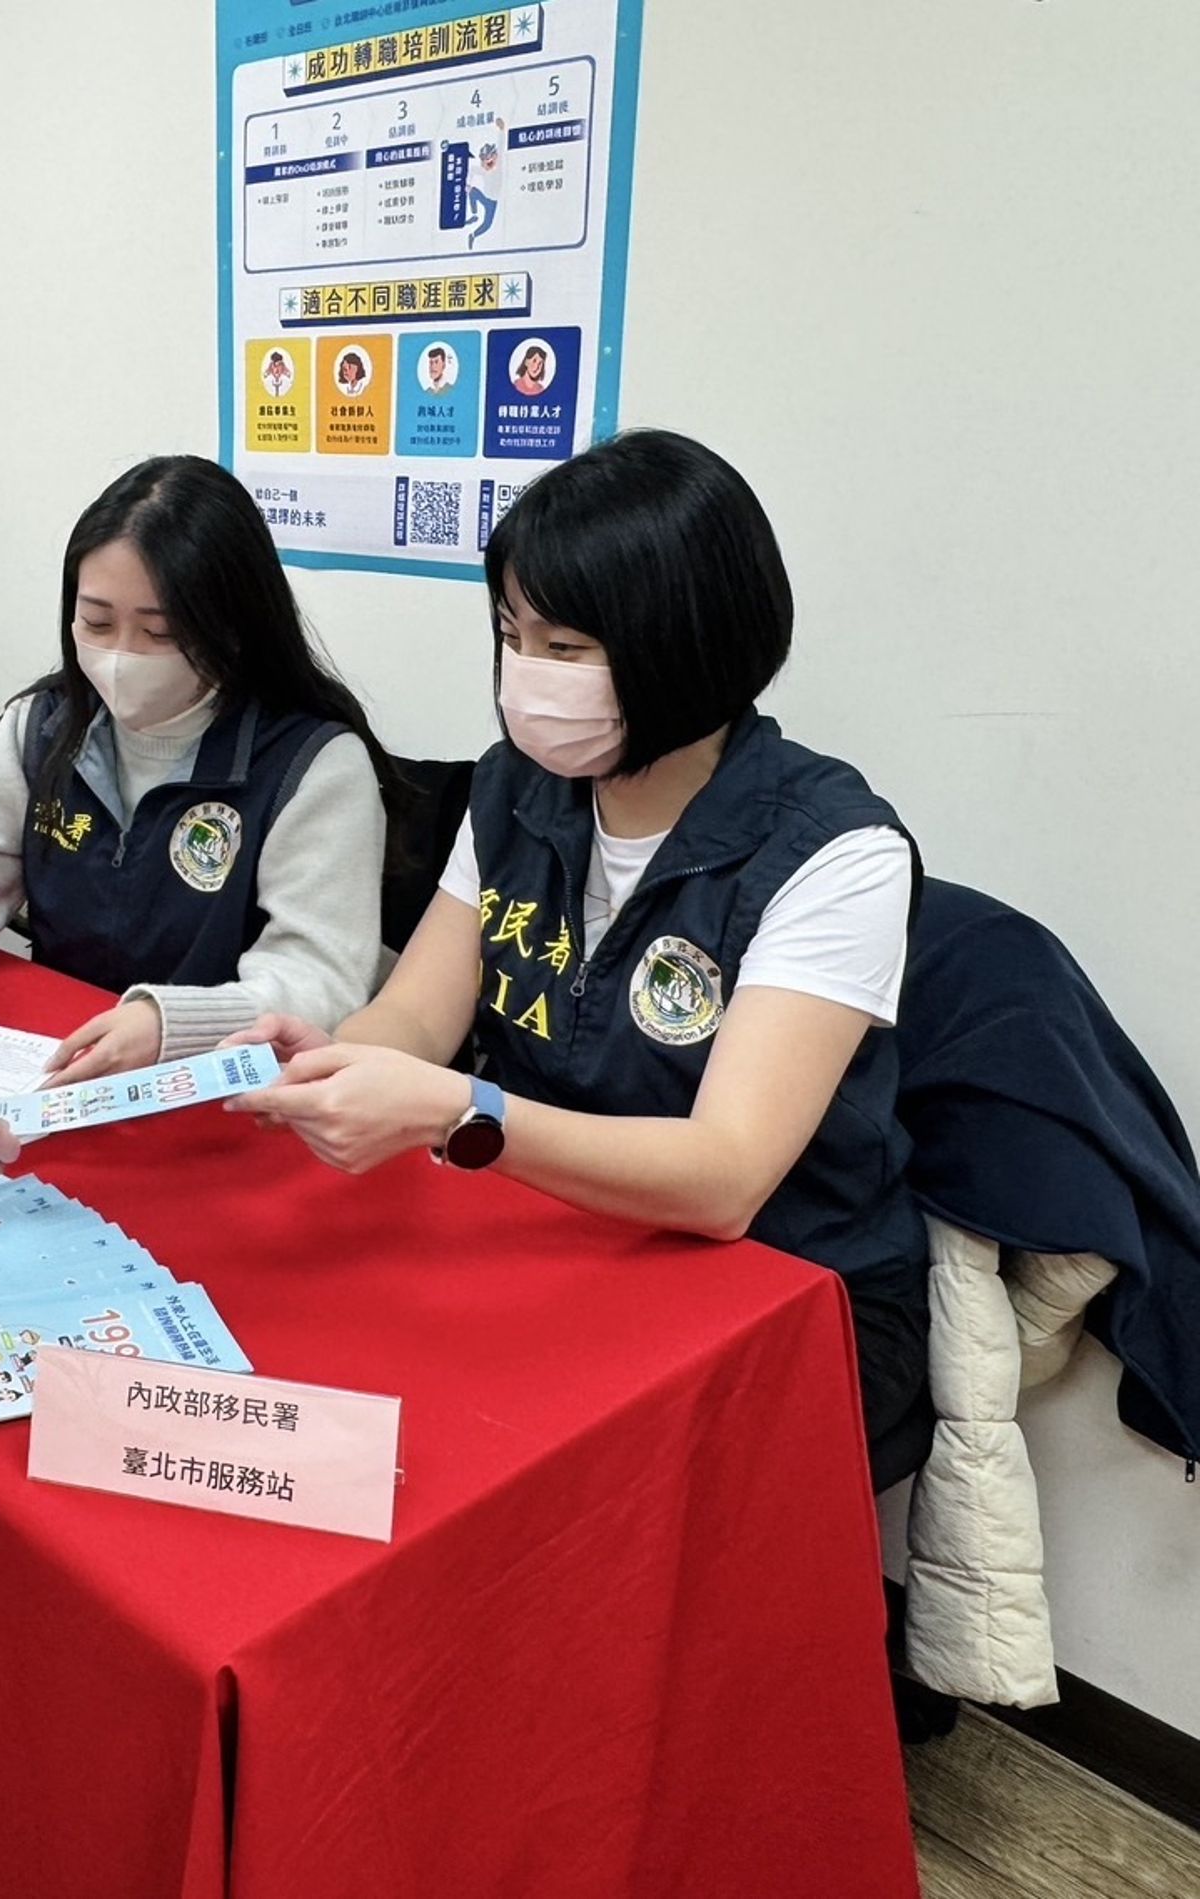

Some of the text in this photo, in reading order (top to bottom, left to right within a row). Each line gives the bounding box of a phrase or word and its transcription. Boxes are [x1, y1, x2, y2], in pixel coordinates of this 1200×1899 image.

[306, 13, 508, 81] 成功轉職培訓流程
[470, 89, 482, 108] 4
[549, 75, 560, 96] 5
[332, 112, 341, 130] 2
[398, 100, 408, 120] 3
[272, 123, 278, 140] 1
[302, 278, 496, 317] 適合不同職涯需求
[155, 1066, 197, 1102] 1990
[126, 1381, 300, 1433] 內政部移民署
[121, 1446, 295, 1502] 臺北市服務站
